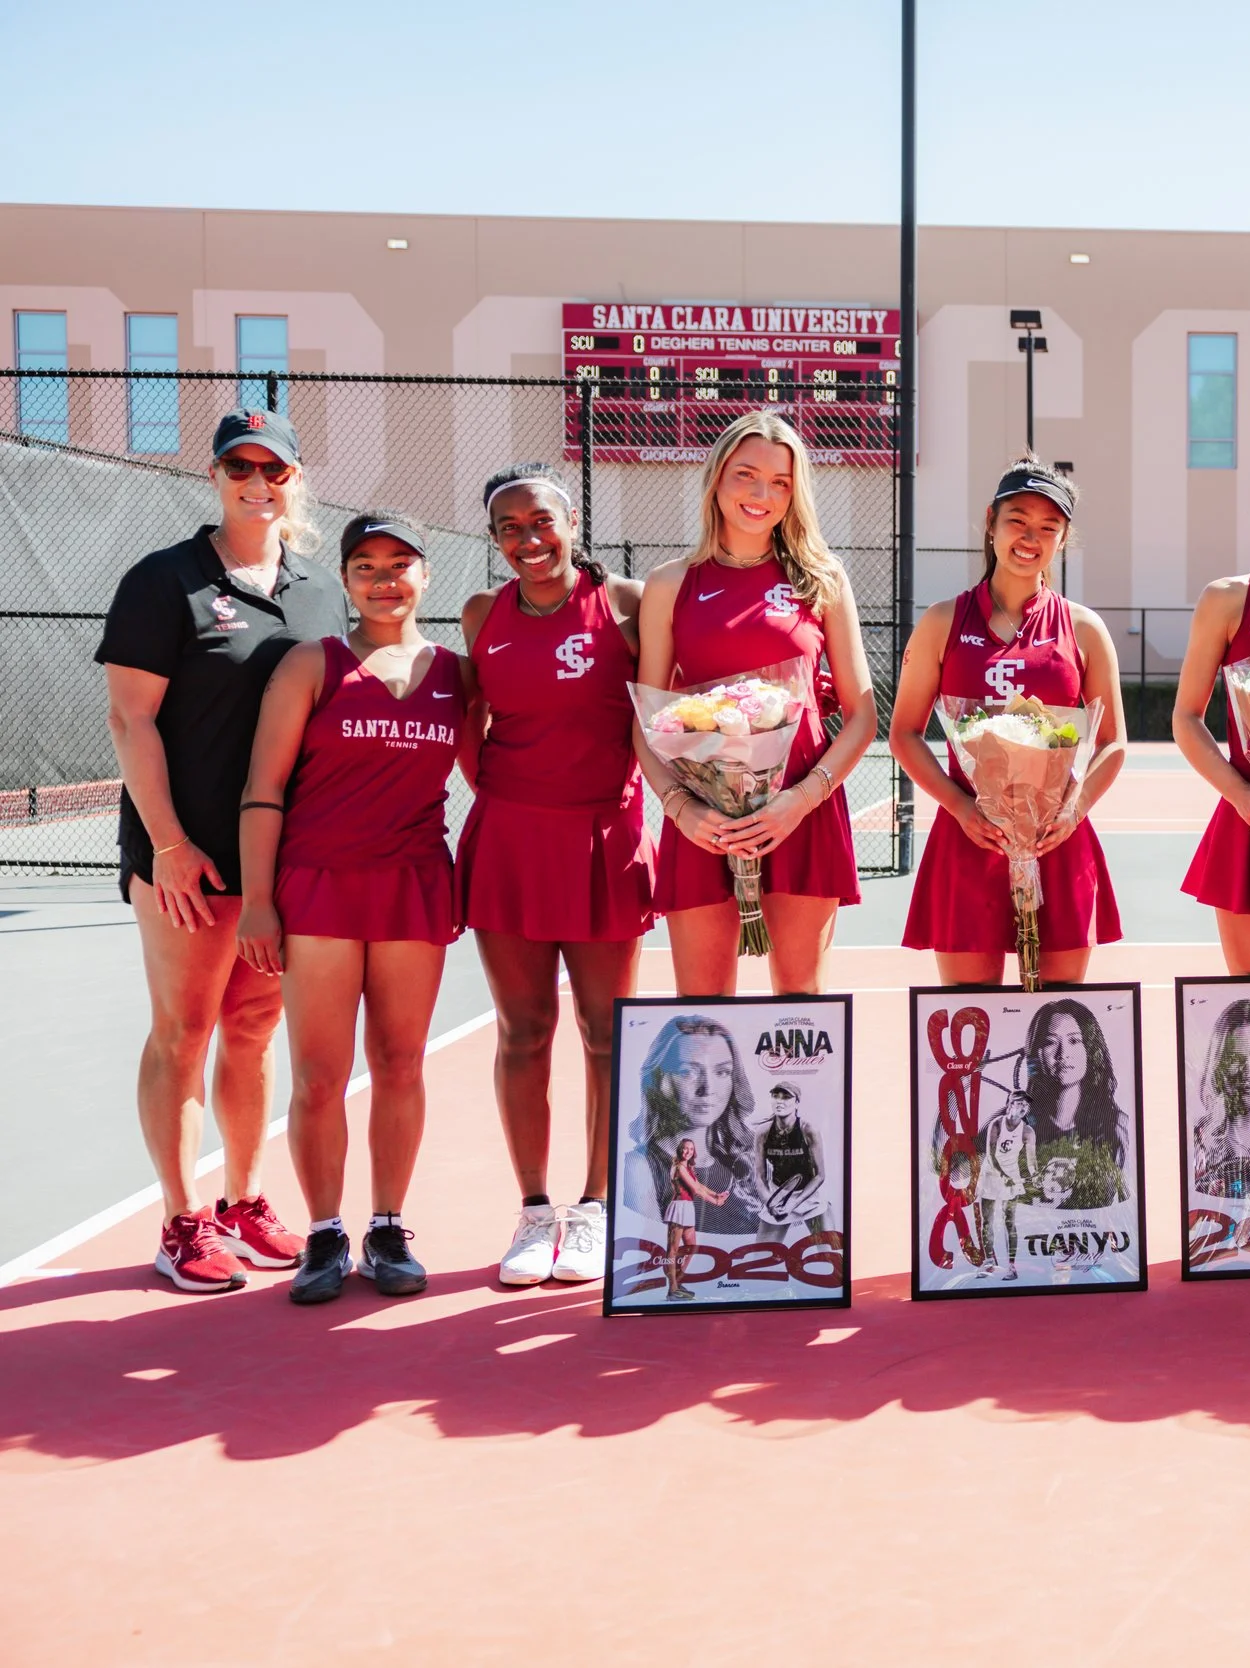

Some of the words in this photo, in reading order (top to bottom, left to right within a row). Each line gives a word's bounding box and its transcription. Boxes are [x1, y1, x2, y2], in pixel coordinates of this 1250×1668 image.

[593, 304, 667, 330] SANTA
[671, 306, 746, 332] CLARA
[751, 307, 888, 335] UNIVERSITY
[570, 335, 595, 351] SCU
[633, 334, 645, 354] 0
[650, 336, 715, 351] DEGHERI
[716, 338, 770, 352] TENNIS
[771, 339, 831, 353] CENTER
[695, 367, 719, 382] SCU
[813, 369, 838, 384] SCU
[639, 450, 707, 462] GIORDANO
[342, 719, 400, 738] SANTA
[404, 721, 455, 746] CLARA
[385, 741, 419, 750] TENNIS
[754, 1029, 834, 1059] ANNA
[946, 1062, 964, 1070] Class
[1024, 1231, 1131, 1256] TIANYU
[612, 1231, 844, 1300] 2026
[652, 1255, 676, 1267] Class
